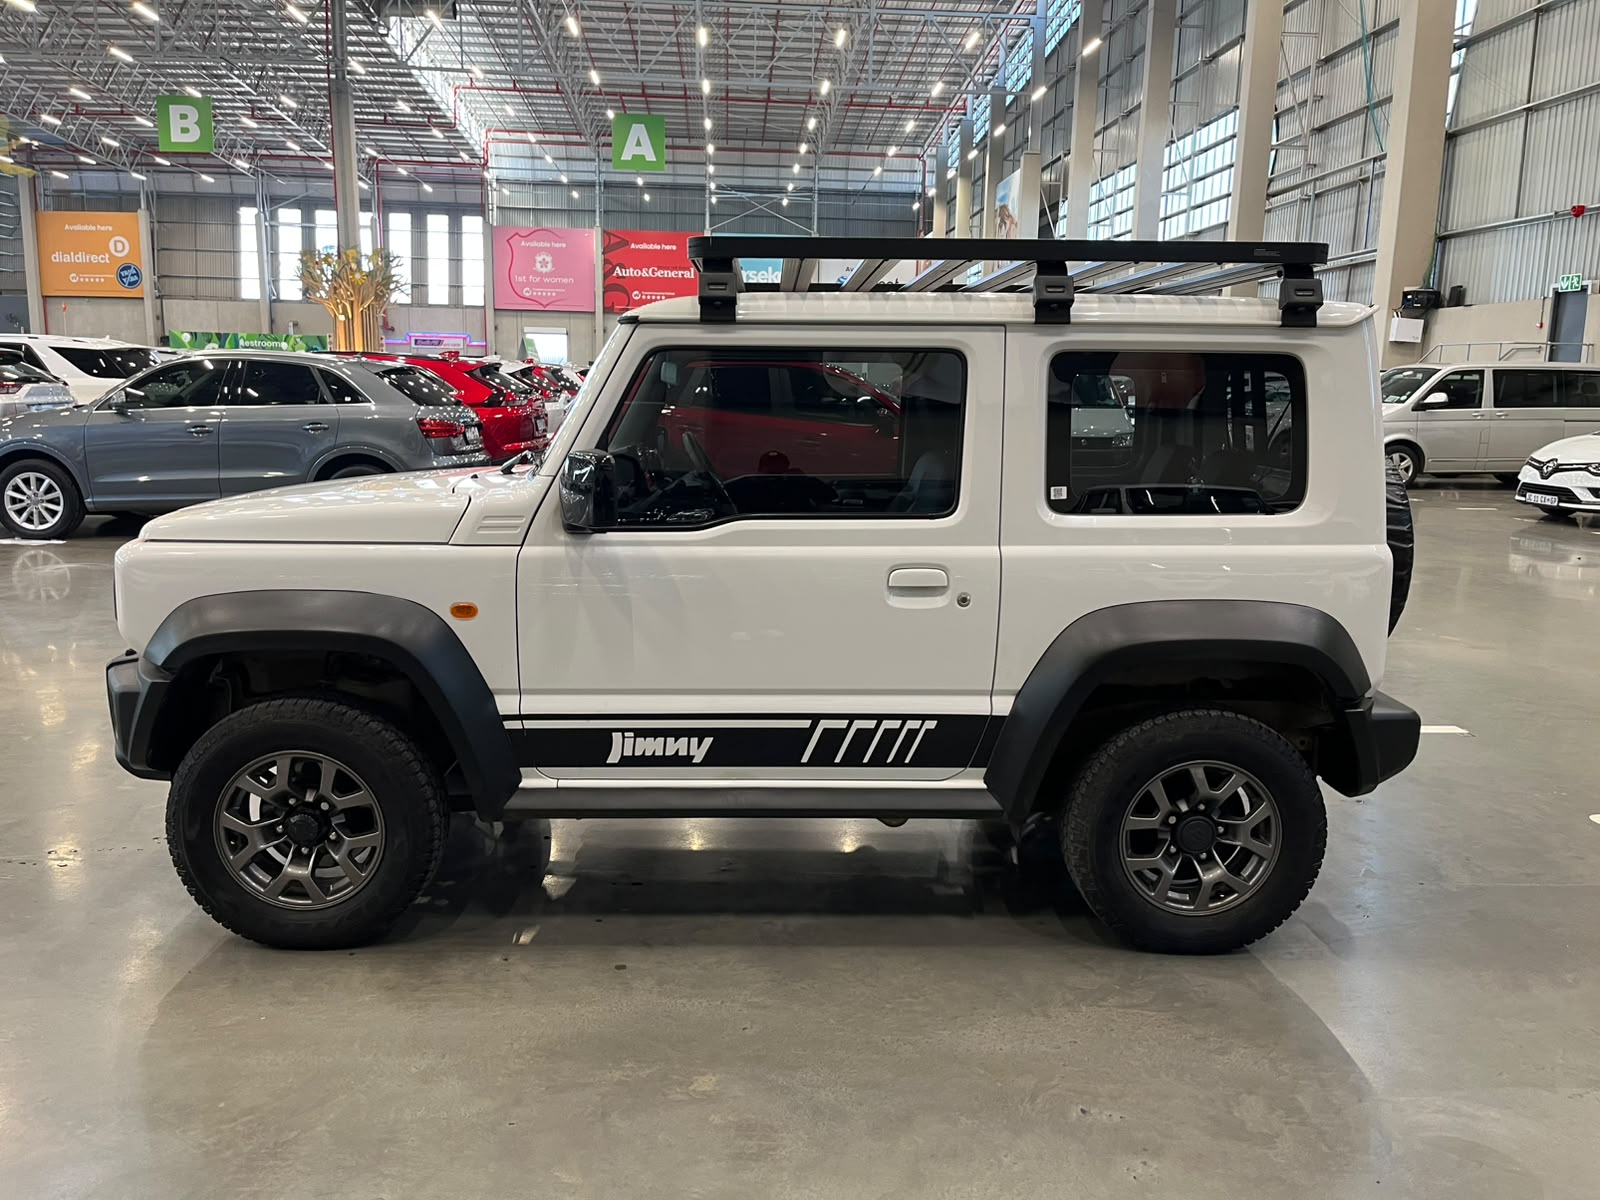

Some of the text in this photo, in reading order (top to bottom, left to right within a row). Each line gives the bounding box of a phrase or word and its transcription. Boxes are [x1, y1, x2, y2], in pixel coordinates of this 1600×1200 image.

[169, 104, 200, 142] B
[621, 123, 657, 161] A
[64, 223, 96, 231] Available
[521, 240, 551, 248] Available
[630, 242, 661, 250] Available
[51, 251, 110, 263] dialdirect
[613, 266, 695, 278] Auto&General
[529, 275, 542, 283] for
[239, 338, 287, 349] Restroom
[606, 732, 714, 763] Jimny
